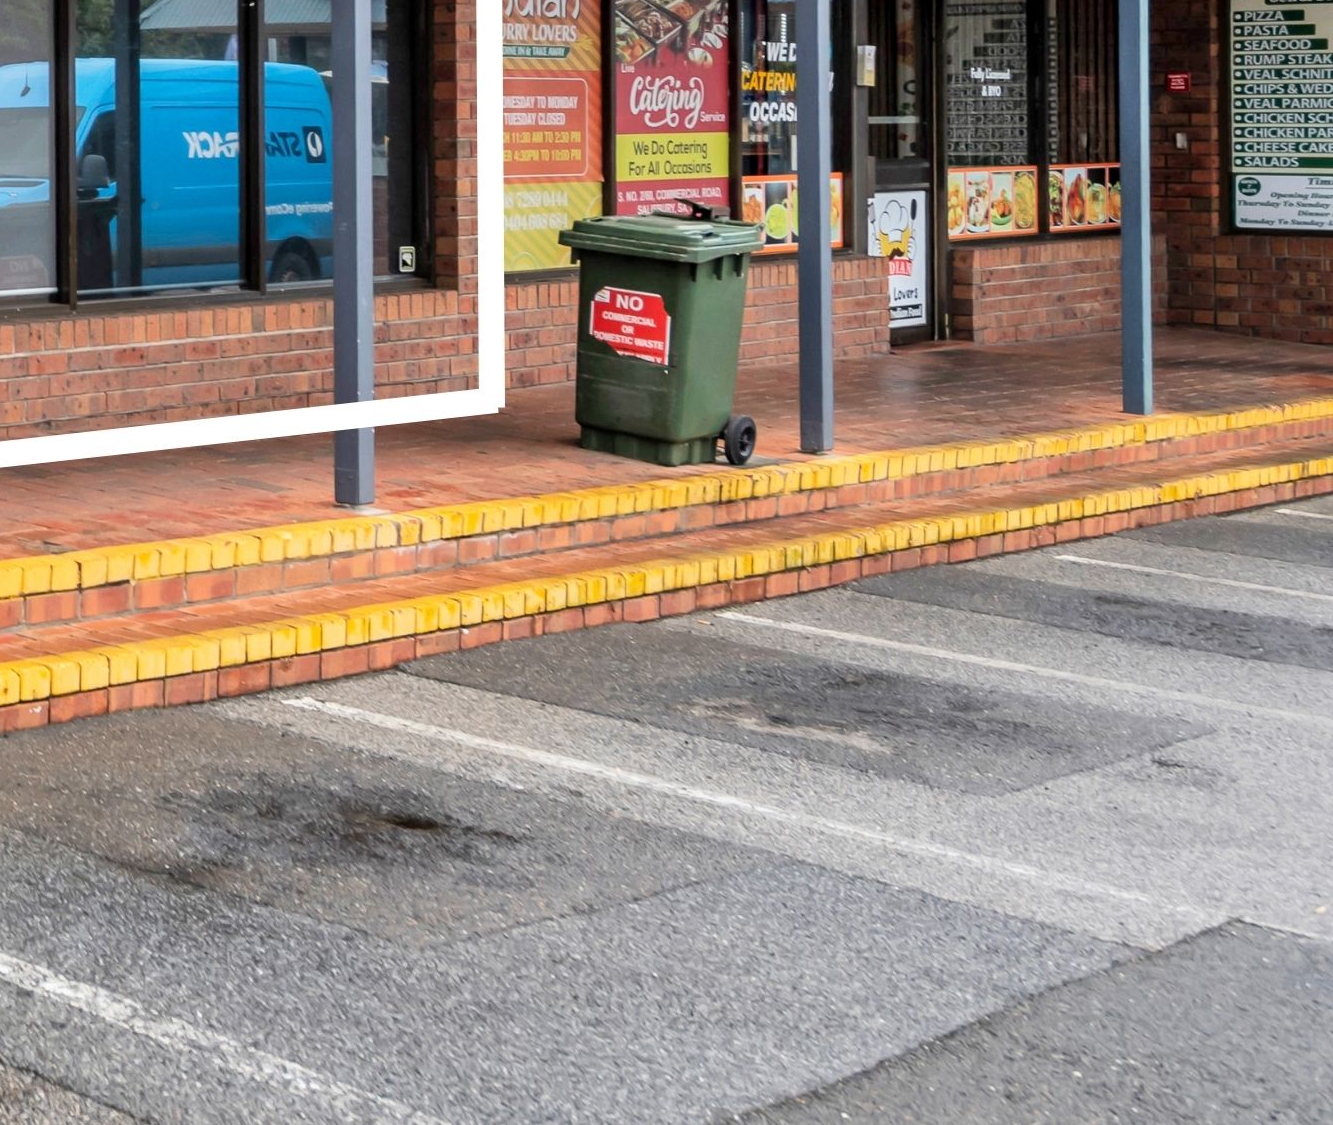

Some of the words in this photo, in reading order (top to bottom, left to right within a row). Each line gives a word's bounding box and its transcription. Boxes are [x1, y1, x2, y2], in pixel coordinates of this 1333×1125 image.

[1244, 11, 1284, 21] PIZZA
[502, 23, 530, 42] URRY
[533, 24, 577, 43] LOVERS
[1244, 25, 1289, 36] PASTA
[1244, 39, 1312, 51] SEAFOOD
[767, 42, 788, 62] WE
[1244, 54, 1285, 65] RUMP
[1288, 53, 1333, 64] STEAK
[621, 63, 635, 73] Live
[971, 67, 984, 82] Fully
[1244, 69, 1280, 80] VEAL
[741, 71, 797, 92] CATERIN
[1244, 83, 1284, 94] CHIPS
[1287, 83, 1298, 94] &
[630, 75, 704, 129] Catering
[1244, 98, 1280, 109] VEAL
[700, 111, 725, 122] Service
[1244, 113, 1304, 123] CHICKEN
[1244, 127, 1304, 138] CHICKEN
[633, 141, 649, 155] We
[651, 140, 665, 155] Do
[667, 139, 708, 159] Catering
[1244, 142, 1297, 152] CHEESE
[629, 161, 645, 176] For
[647, 161, 660, 175] All
[664, 160, 712, 175] Occasions
[1244, 157, 1299, 167] SALADS
[889, 261, 912, 274] DIAN
[894, 287, 918, 301] Lovers
[615, 294, 644, 311] NO
[602, 310, 656, 327] COMMERCIAL
[621, 325, 635, 335] OR
[634, 338, 665, 350] WASTE
